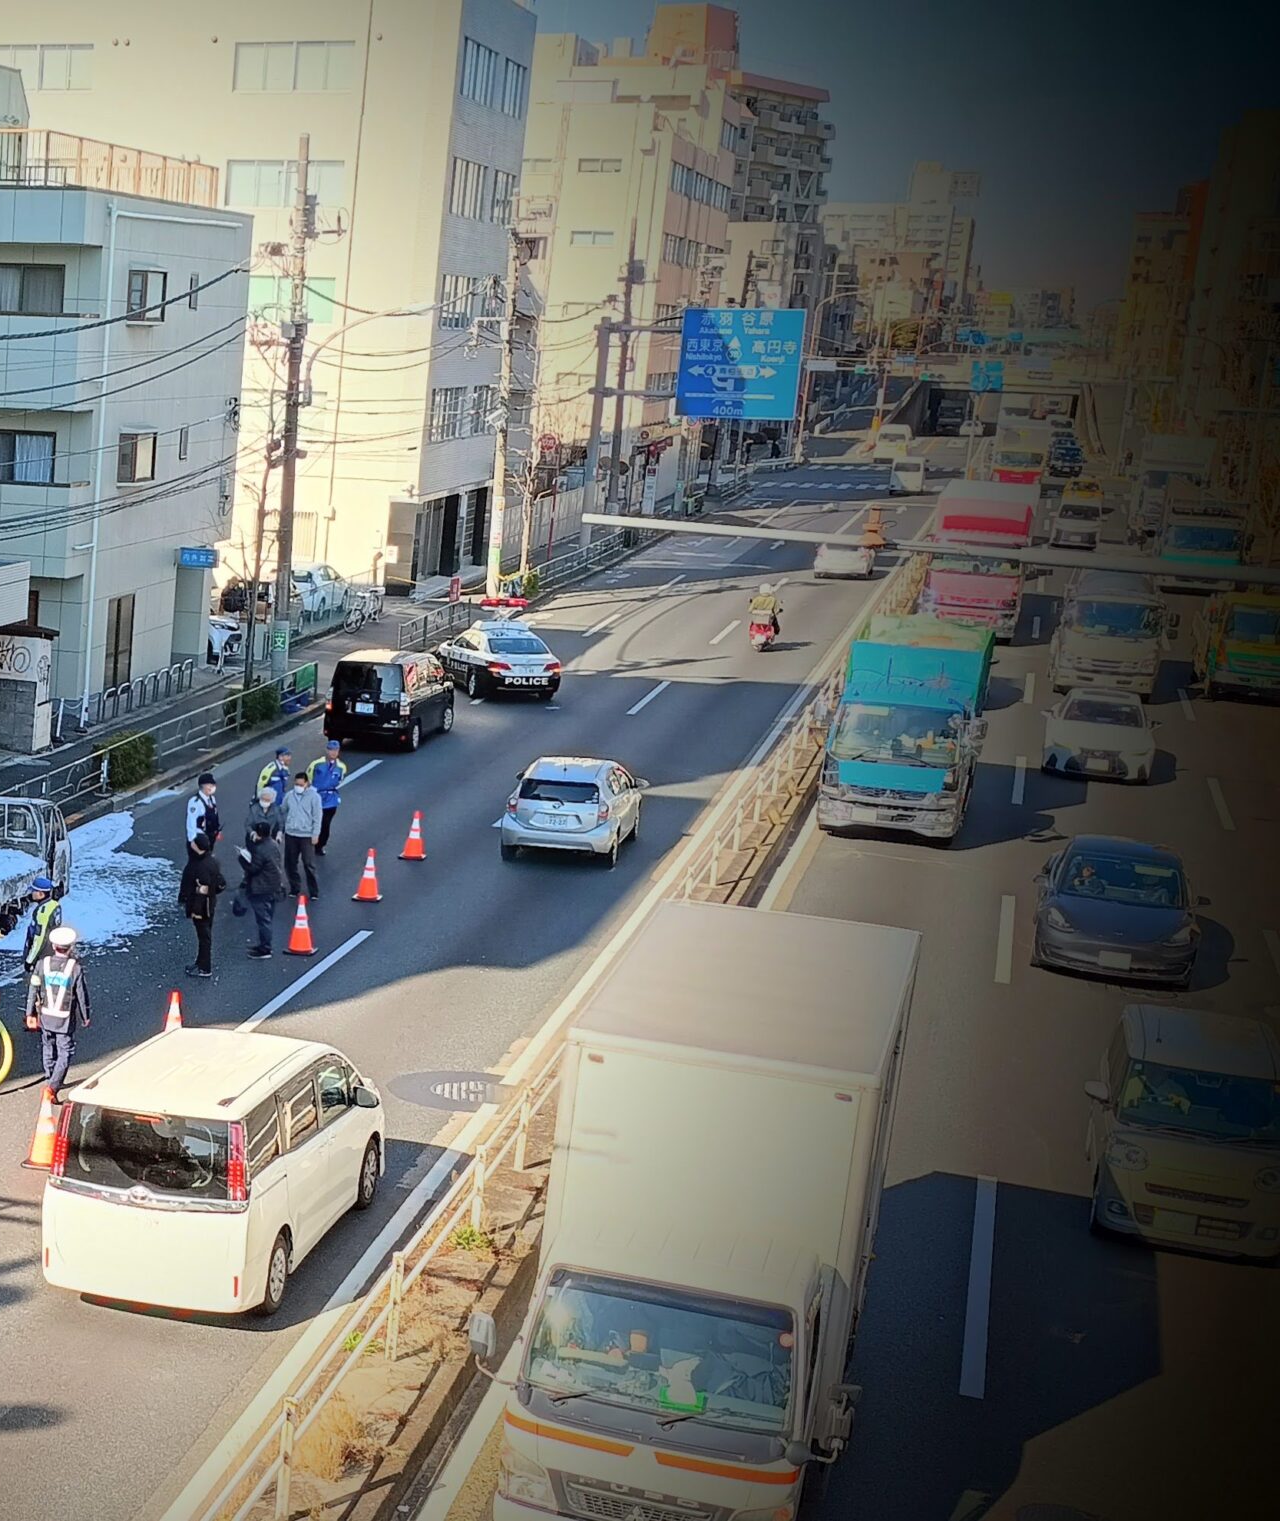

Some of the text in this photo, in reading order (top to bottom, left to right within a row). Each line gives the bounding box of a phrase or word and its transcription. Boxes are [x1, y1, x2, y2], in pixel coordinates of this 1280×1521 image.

[686, 338, 723, 352] 西東京
[751, 339, 798, 354] 高円寺
[712, 405, 743, 416] 400m
[505, 677, 549, 686] POLICE
